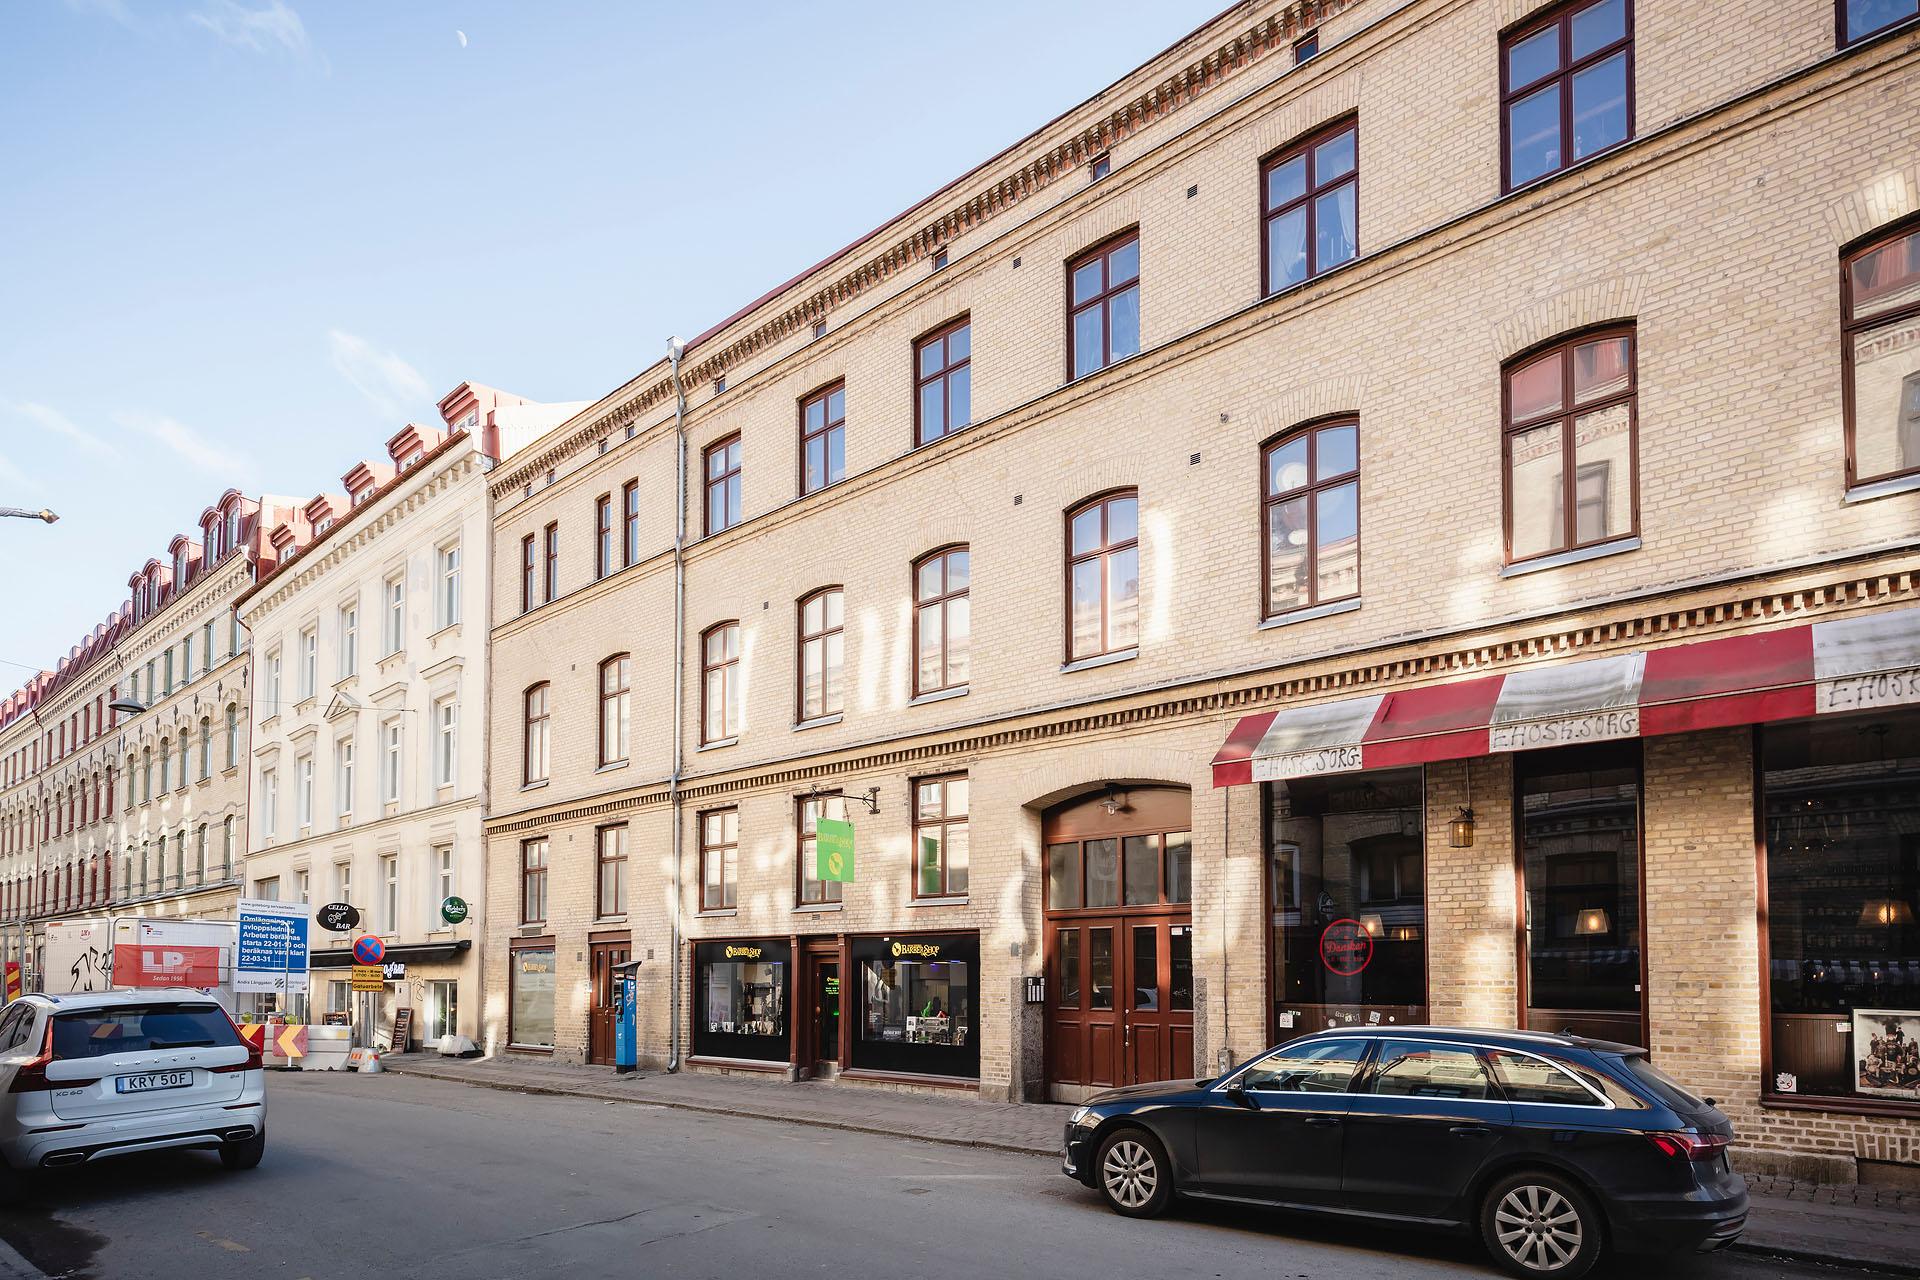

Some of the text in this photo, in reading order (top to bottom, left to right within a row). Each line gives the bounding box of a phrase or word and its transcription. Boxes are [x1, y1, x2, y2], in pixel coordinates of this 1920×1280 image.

[242, 931, 268, 939] Arbetet
[241, 947, 273, 955] beräknas
[129, 1073, 187, 1089] KRY 50F
